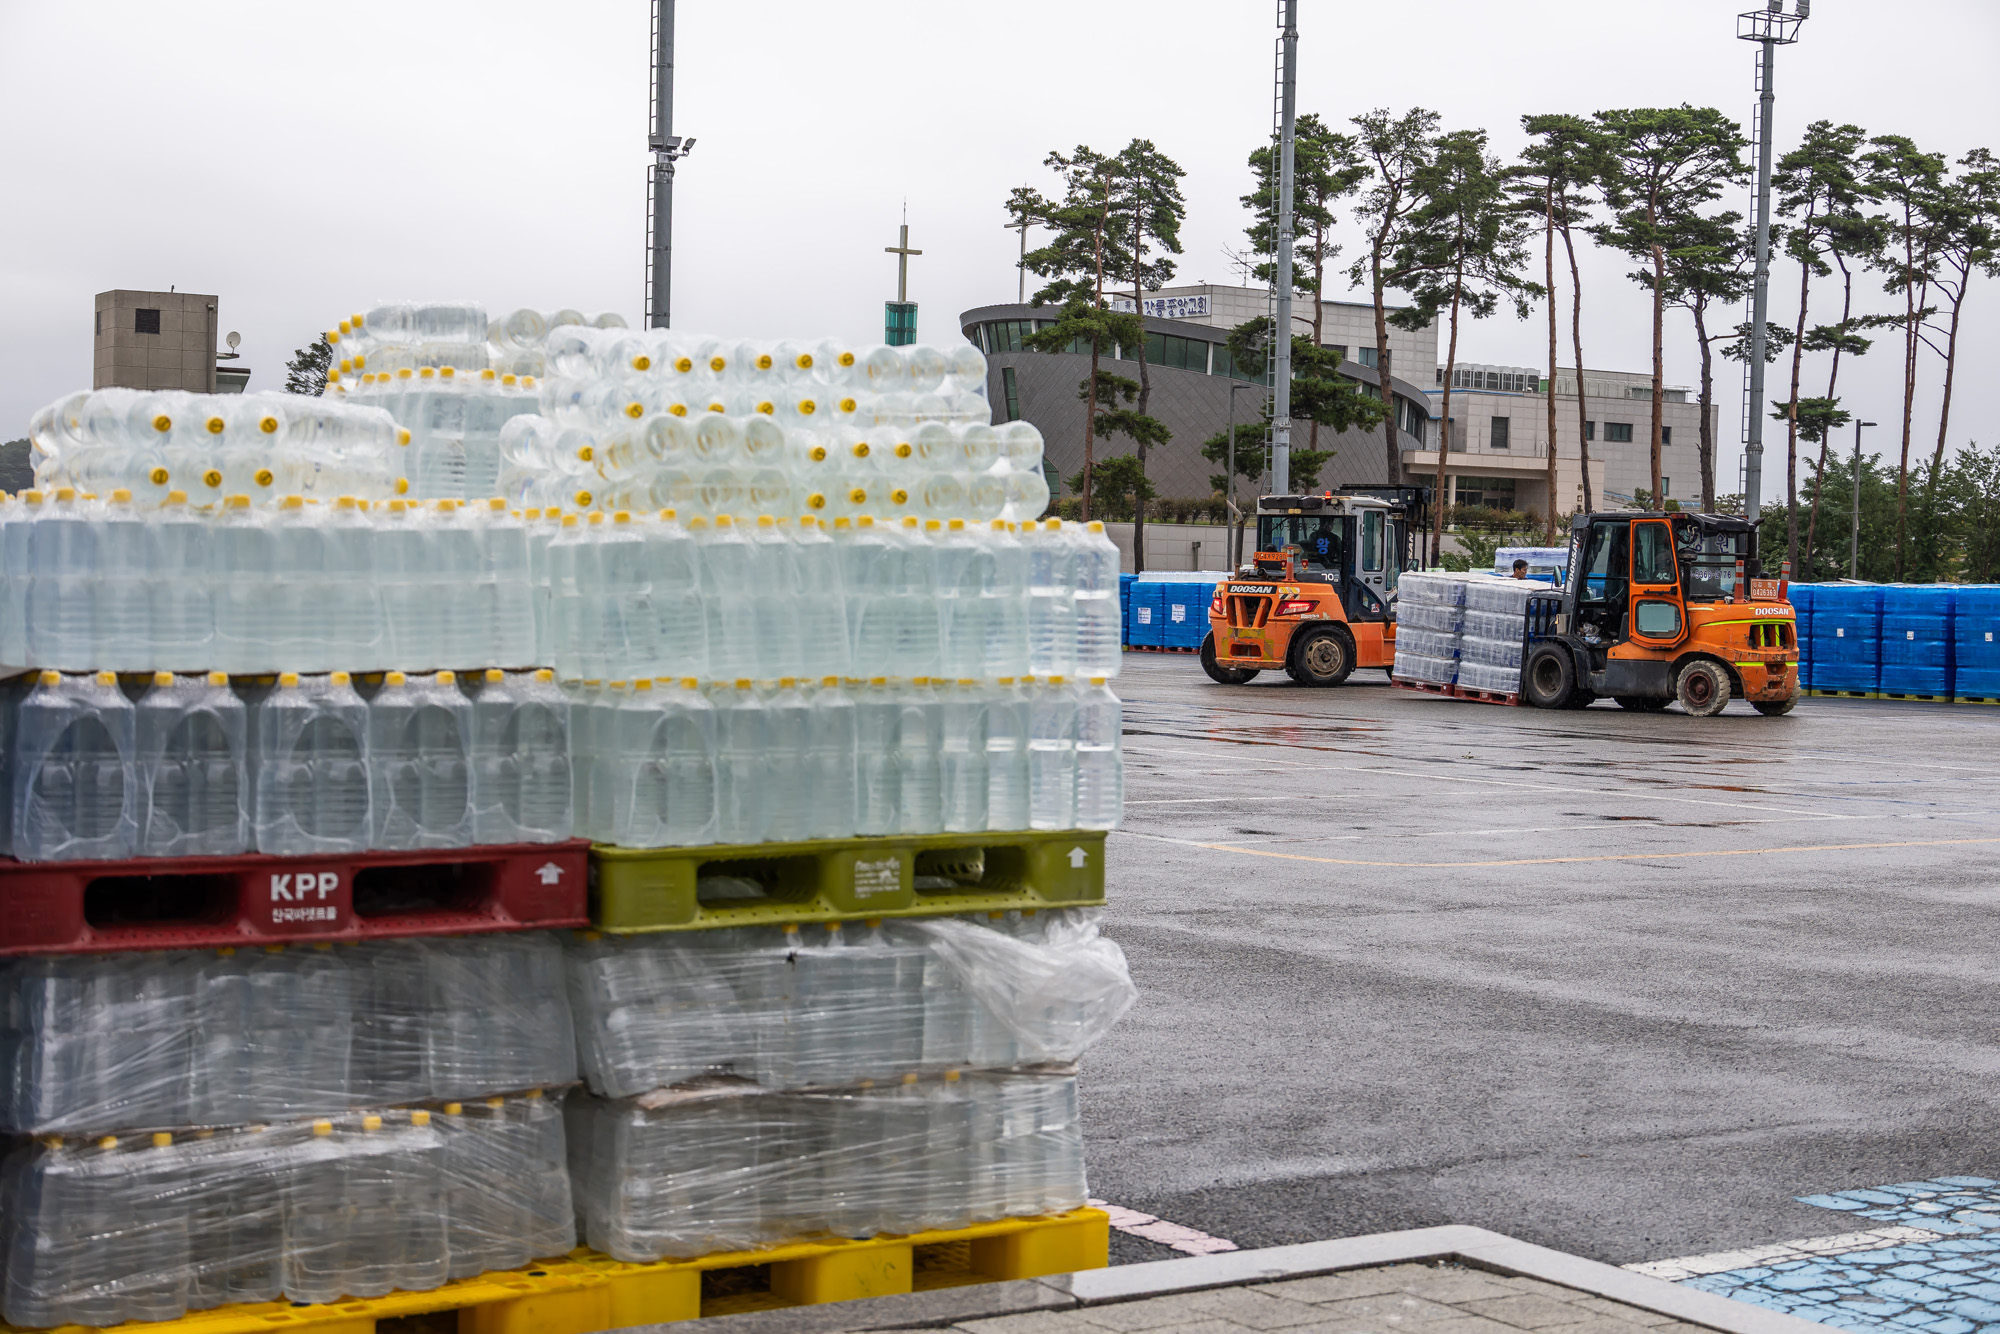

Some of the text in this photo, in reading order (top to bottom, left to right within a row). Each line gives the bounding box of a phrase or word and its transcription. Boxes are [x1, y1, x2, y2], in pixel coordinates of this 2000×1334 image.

[1144, 296, 1207, 317] 강릉중앙교회
[1316, 538, 1330, 554] 왕
[1230, 585, 1272, 593] DOOSAN
[1755, 607, 1789, 615] DOOSAN
[271, 872, 339, 901] KPP
